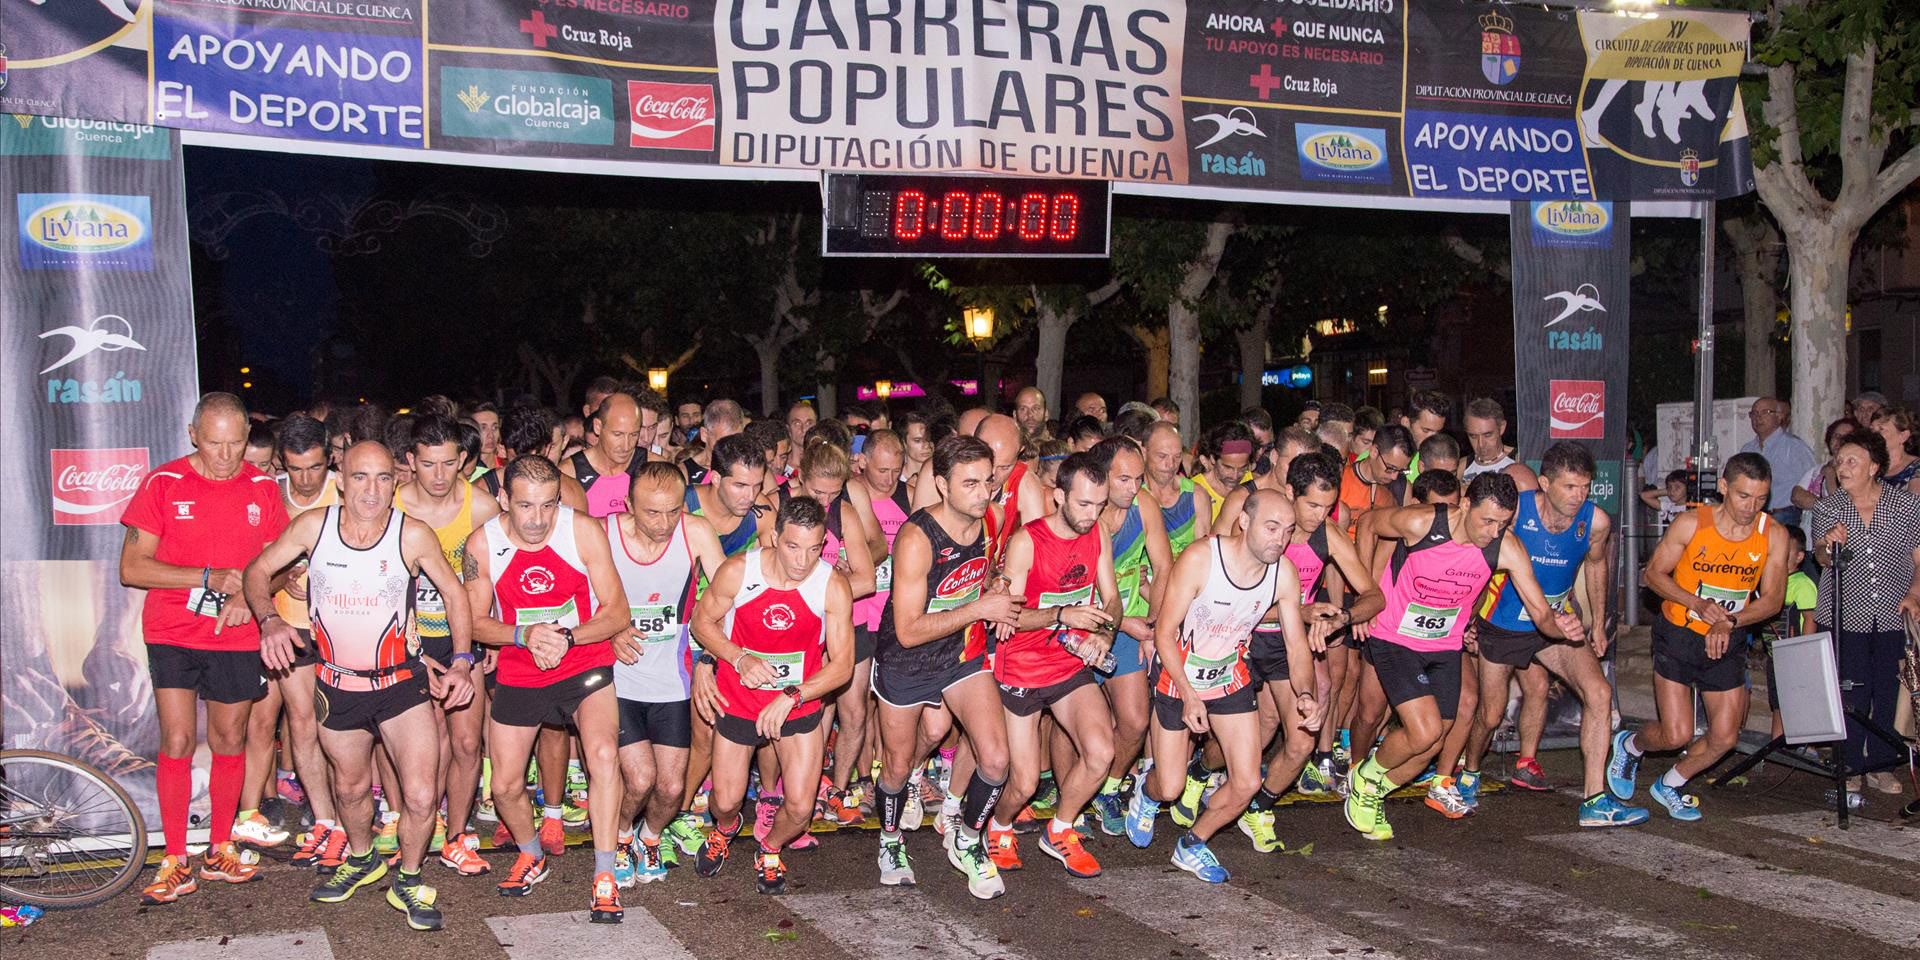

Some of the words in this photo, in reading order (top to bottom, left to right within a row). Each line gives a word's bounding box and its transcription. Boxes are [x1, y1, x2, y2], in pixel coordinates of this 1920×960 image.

[336, 2, 354, 15] DE
[356, 3, 412, 20] CUENCA
[584, 0, 689, 19] NECESARIO
[562, 25, 596, 45] Cruz
[599, 29, 633, 51] Roja
[729, 0, 1170, 75] CARRERAS
[1206, 13, 1265, 34] AHORA
[1293, 21, 1325, 39] QUE
[1329, 25, 1384, 44] NUNCA
[1667, 21, 1688, 39] XV
[168, 34, 412, 83] APOYANDO
[1206, 37, 1224, 51] TU
[1227, 40, 1278, 56] APOYO
[1282, 45, 1300, 58] ES
[1304, 47, 1384, 65] NECESARIO
[1595, 39, 1639, 52] CIRCUITO
[1653, 40, 1693, 55] CARRERAS
[1624, 55, 1669, 70] DIPUTACIÓN
[1673, 58, 1683, 70] DE
[1686, 58, 1721, 71] CUENCA
[511, 85, 589, 97] FUNDACIÓN
[1284, 75, 1310, 92] Cruz
[1312, 77, 1338, 98] Roja
[1415, 84, 1472, 98] DIPUTACIÓN
[1472, 88, 1524, 102] PROVINCIAL
[1525, 92, 1536, 103] DE
[1537, 93, 1572, 105] CUENCA
[157, 81, 208, 121] EL
[229, 89, 423, 140] DEPORTE
[494, 93, 601, 126] Globalcaja
[636, 94, 710, 120] Coca-Cola
[731, 59, 1175, 142] POPULARES
[525, 118, 570, 129] Cuenca
[75, 130, 122, 143] Cuenca
[1414, 122, 1574, 153] APOYANDO
[733, 133, 962, 169] DIPUTACIÓN
[979, 139, 1017, 171] DE
[1030, 144, 1175, 181] CUENCA
[1314, 141, 1373, 161] Liviana
[1201, 151, 1266, 177] rasán
[1412, 164, 1448, 192] EL
[1457, 166, 1590, 195] DEPORTE
[895, 190, 1079, 240] 0:00:00
[1547, 207, 1600, 227] Liviana
[41, 216, 129, 243] Liviana
[1549, 326, 1603, 350] rasán
[47, 371, 142, 405] rasán
[1553, 391, 1602, 415] Coca-Cola
[57, 463, 144, 493] Coca-Cola
[1590, 480, 1614, 500] lcaja
[1531, 555, 1568, 567] rujamar
[943, 561, 986, 593] Conchel
[1445, 568, 1482, 580] Gamo
[1414, 615, 1447, 630] 463
[1195, 665, 1228, 681] 184
